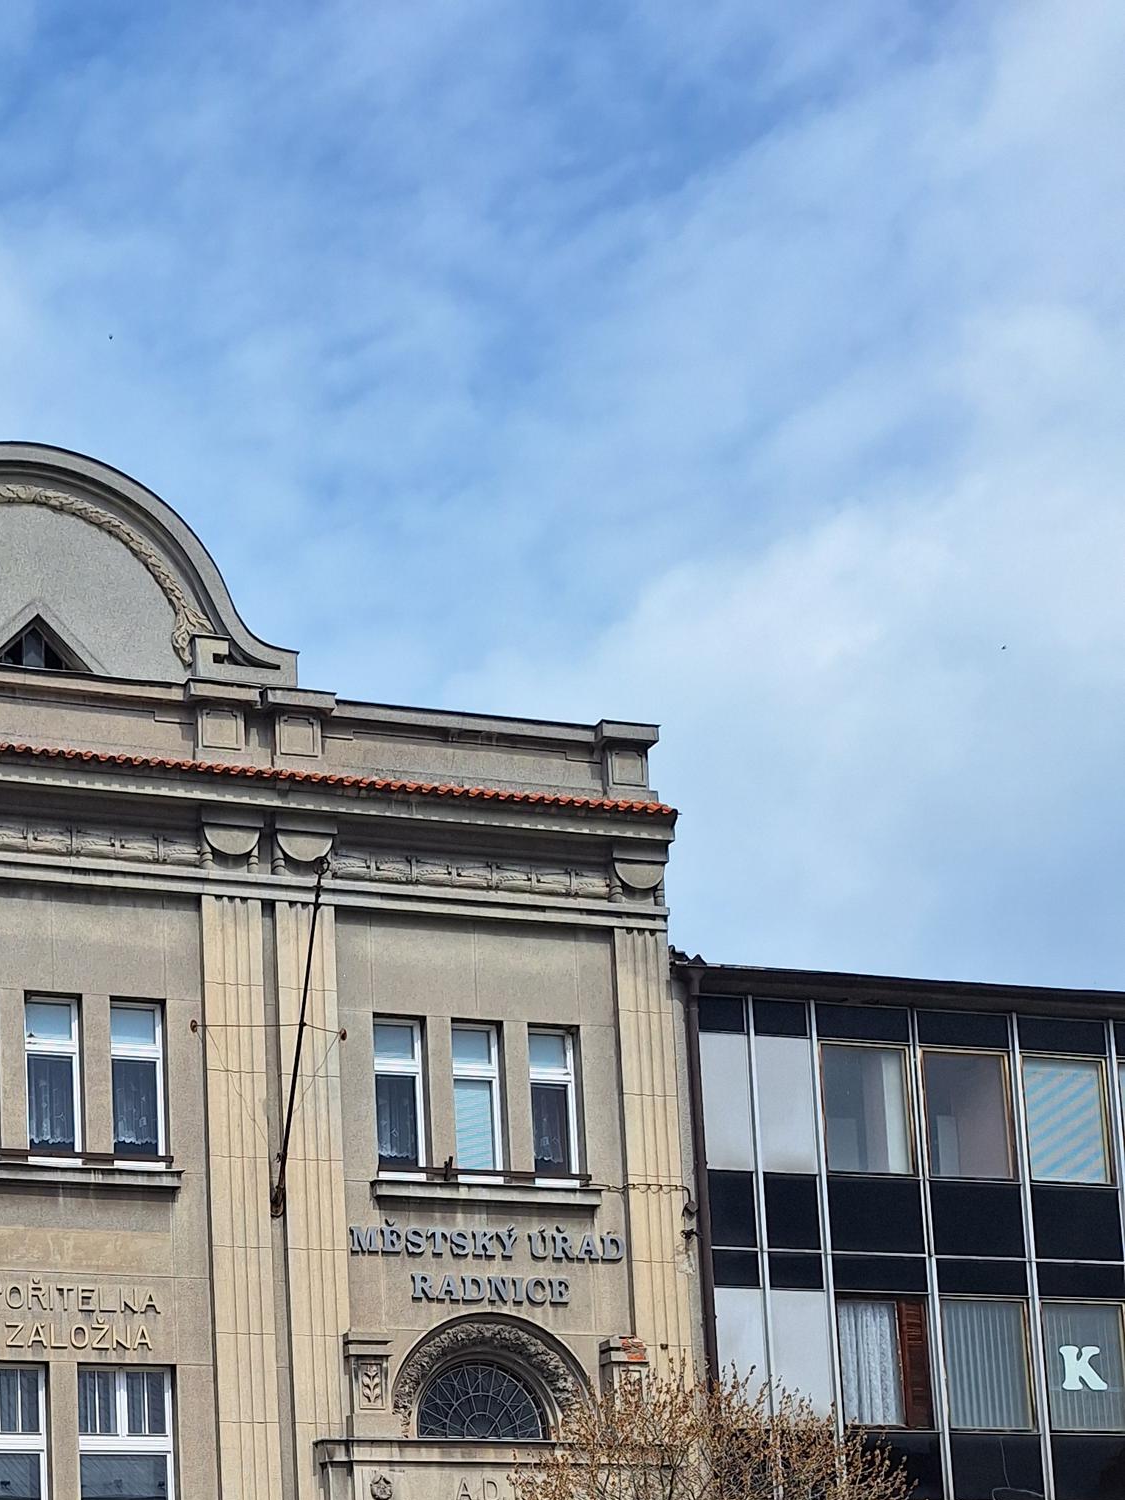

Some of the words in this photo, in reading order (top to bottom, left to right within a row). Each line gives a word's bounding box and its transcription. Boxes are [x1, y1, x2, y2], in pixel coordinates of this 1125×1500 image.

[349, 1219, 518, 1259] MĚSTSKÝ
[527, 1225, 625, 1261] ÚŘAD
[410, 1272, 571, 1304] RADNICE
[5, 1317, 153, 1350] ZÁLOŽNA
[1059, 1345, 1108, 1391] K
